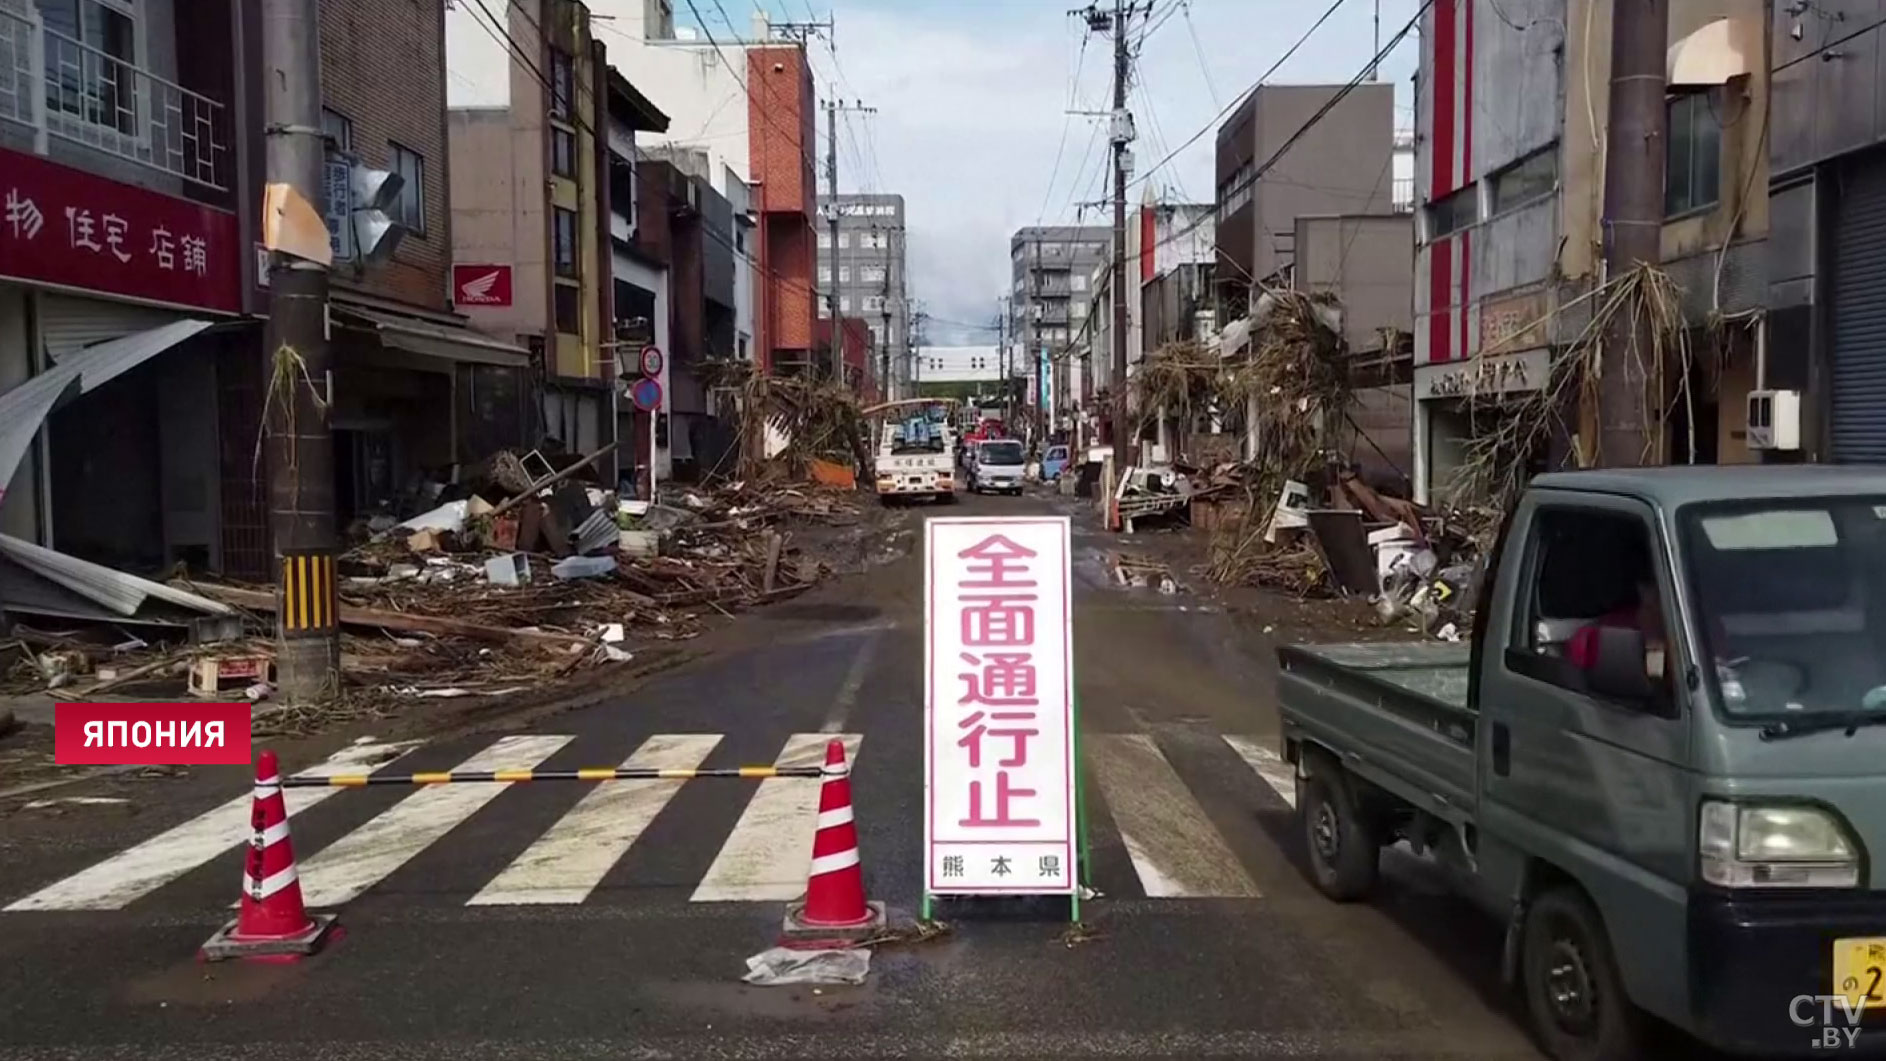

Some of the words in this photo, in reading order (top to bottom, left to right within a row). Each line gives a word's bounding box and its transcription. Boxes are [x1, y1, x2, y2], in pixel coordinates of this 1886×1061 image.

[6, 187, 44, 240] 物
[65, 206, 132, 263] 住宅
[149, 225, 207, 276] 店舗
[957, 533, 1042, 828] 全面通行止
[942, 855, 1060, 877] 熊本県
[1866, 966, 1883, 1001] 2
